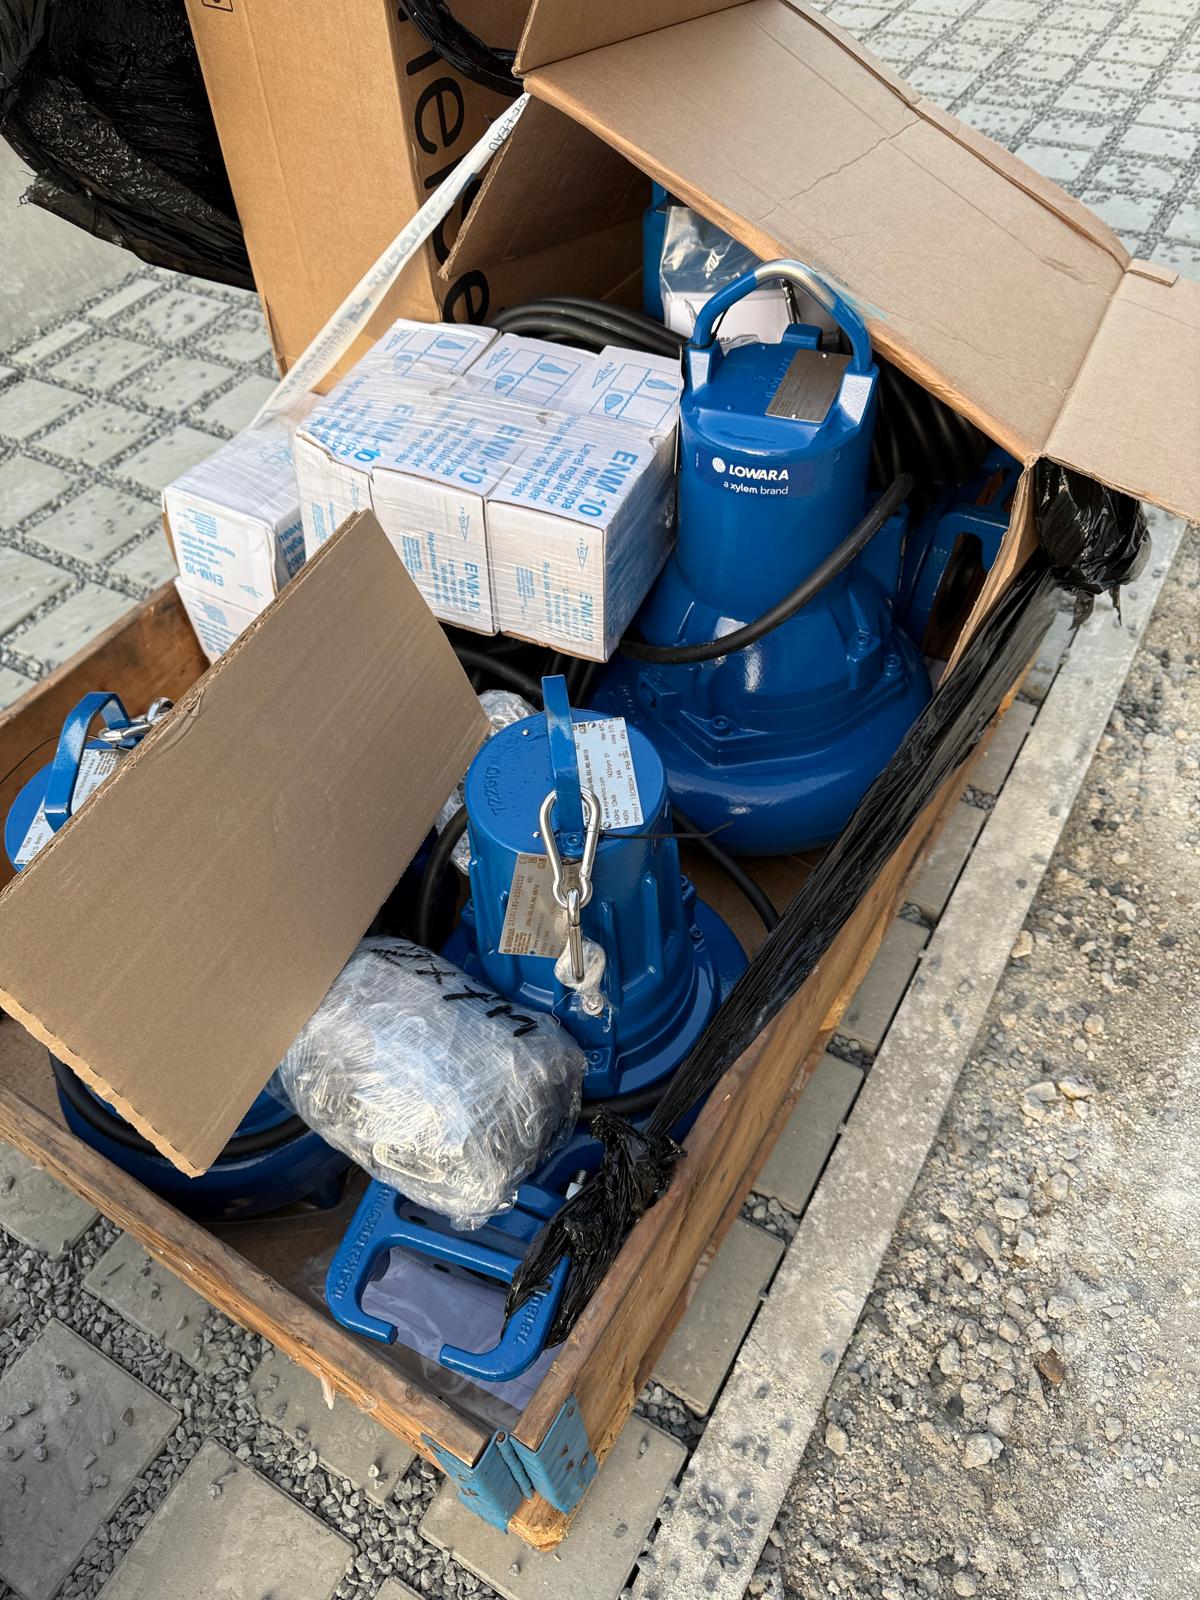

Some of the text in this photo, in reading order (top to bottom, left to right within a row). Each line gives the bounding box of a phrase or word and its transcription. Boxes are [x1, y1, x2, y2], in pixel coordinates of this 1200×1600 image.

[459, 424, 523, 484] ENM-10
[533, 455, 548, 468] de
[511, 467, 539, 497] niveau
[545, 443, 597, 505] Level regulator
[578, 450, 639, 517] ENM-10
[729, 464, 789, 481] LOWARA
[723, 480, 789, 495] a xylem brand
[184, 561, 224, 588] ENM-10
